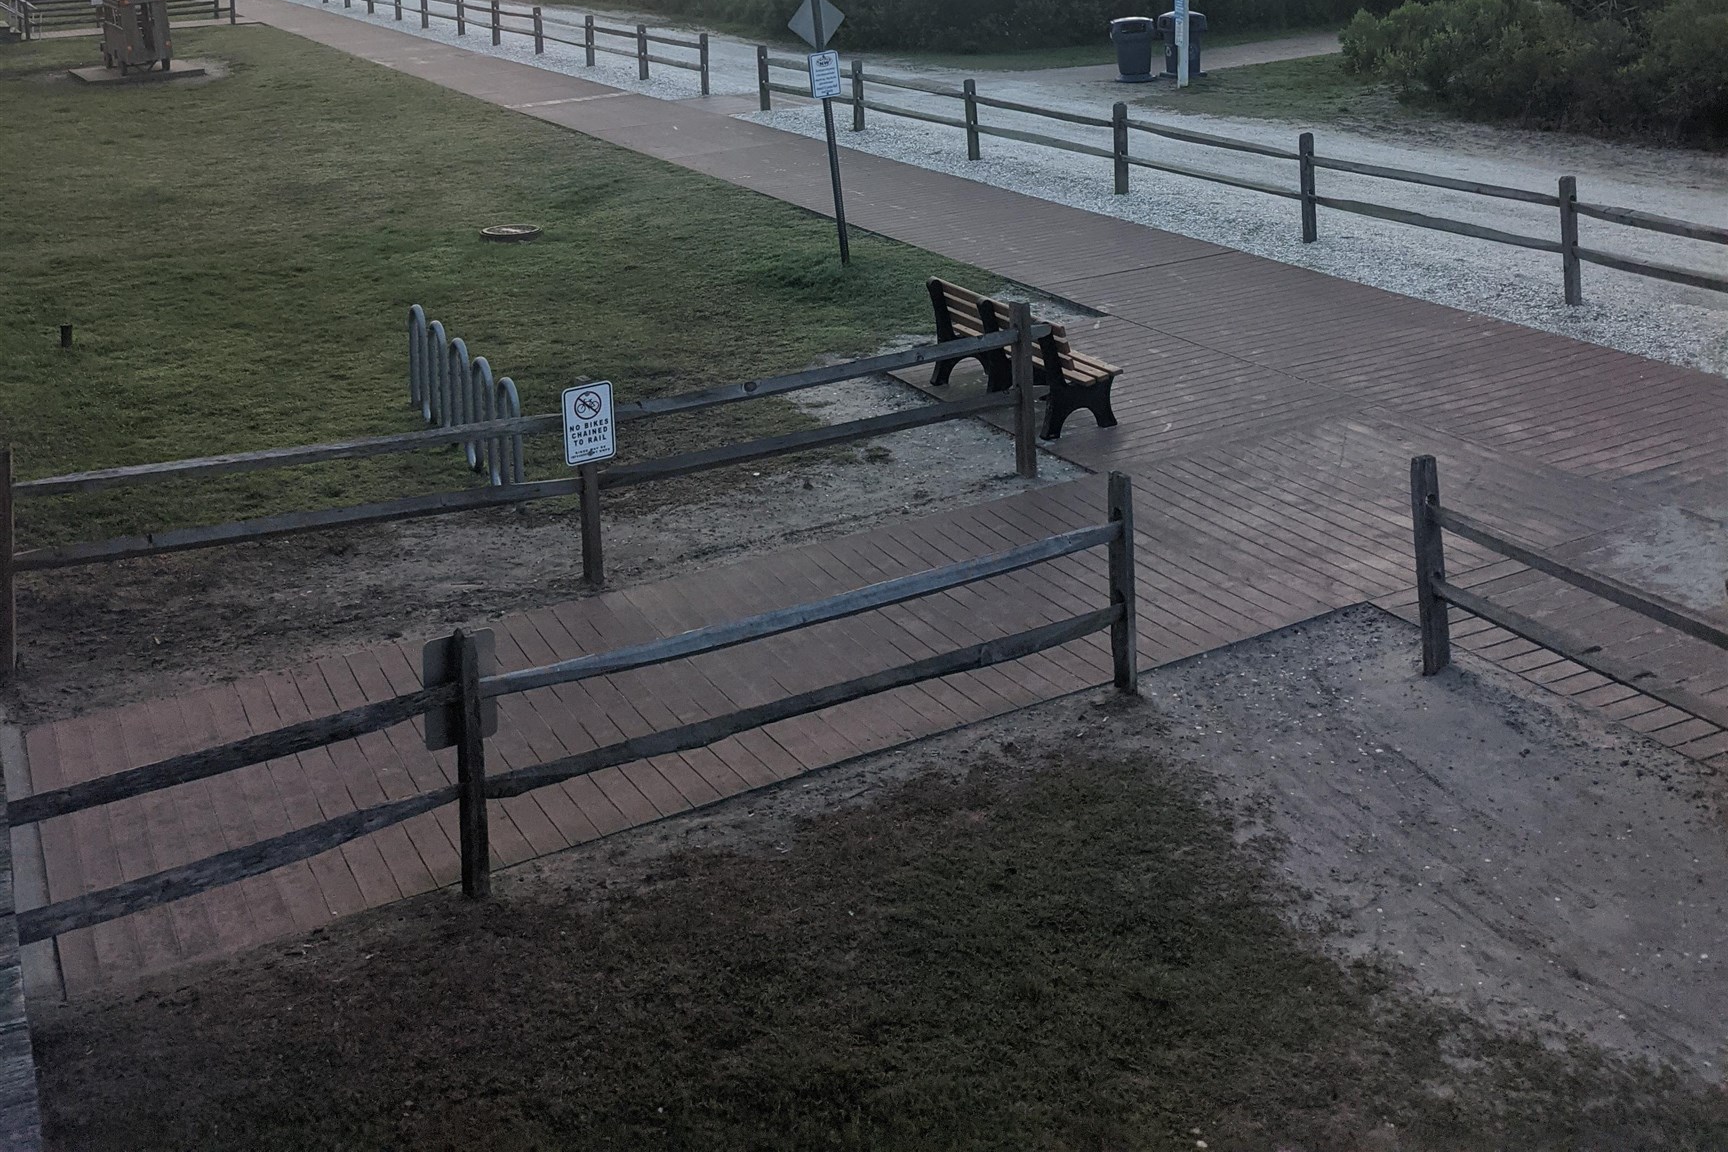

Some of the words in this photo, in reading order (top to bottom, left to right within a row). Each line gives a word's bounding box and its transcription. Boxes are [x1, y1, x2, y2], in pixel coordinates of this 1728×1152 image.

[584, 418, 608, 429] BIKES
[572, 426, 607, 439] CHAINED
[588, 434, 606, 443] RAIL
